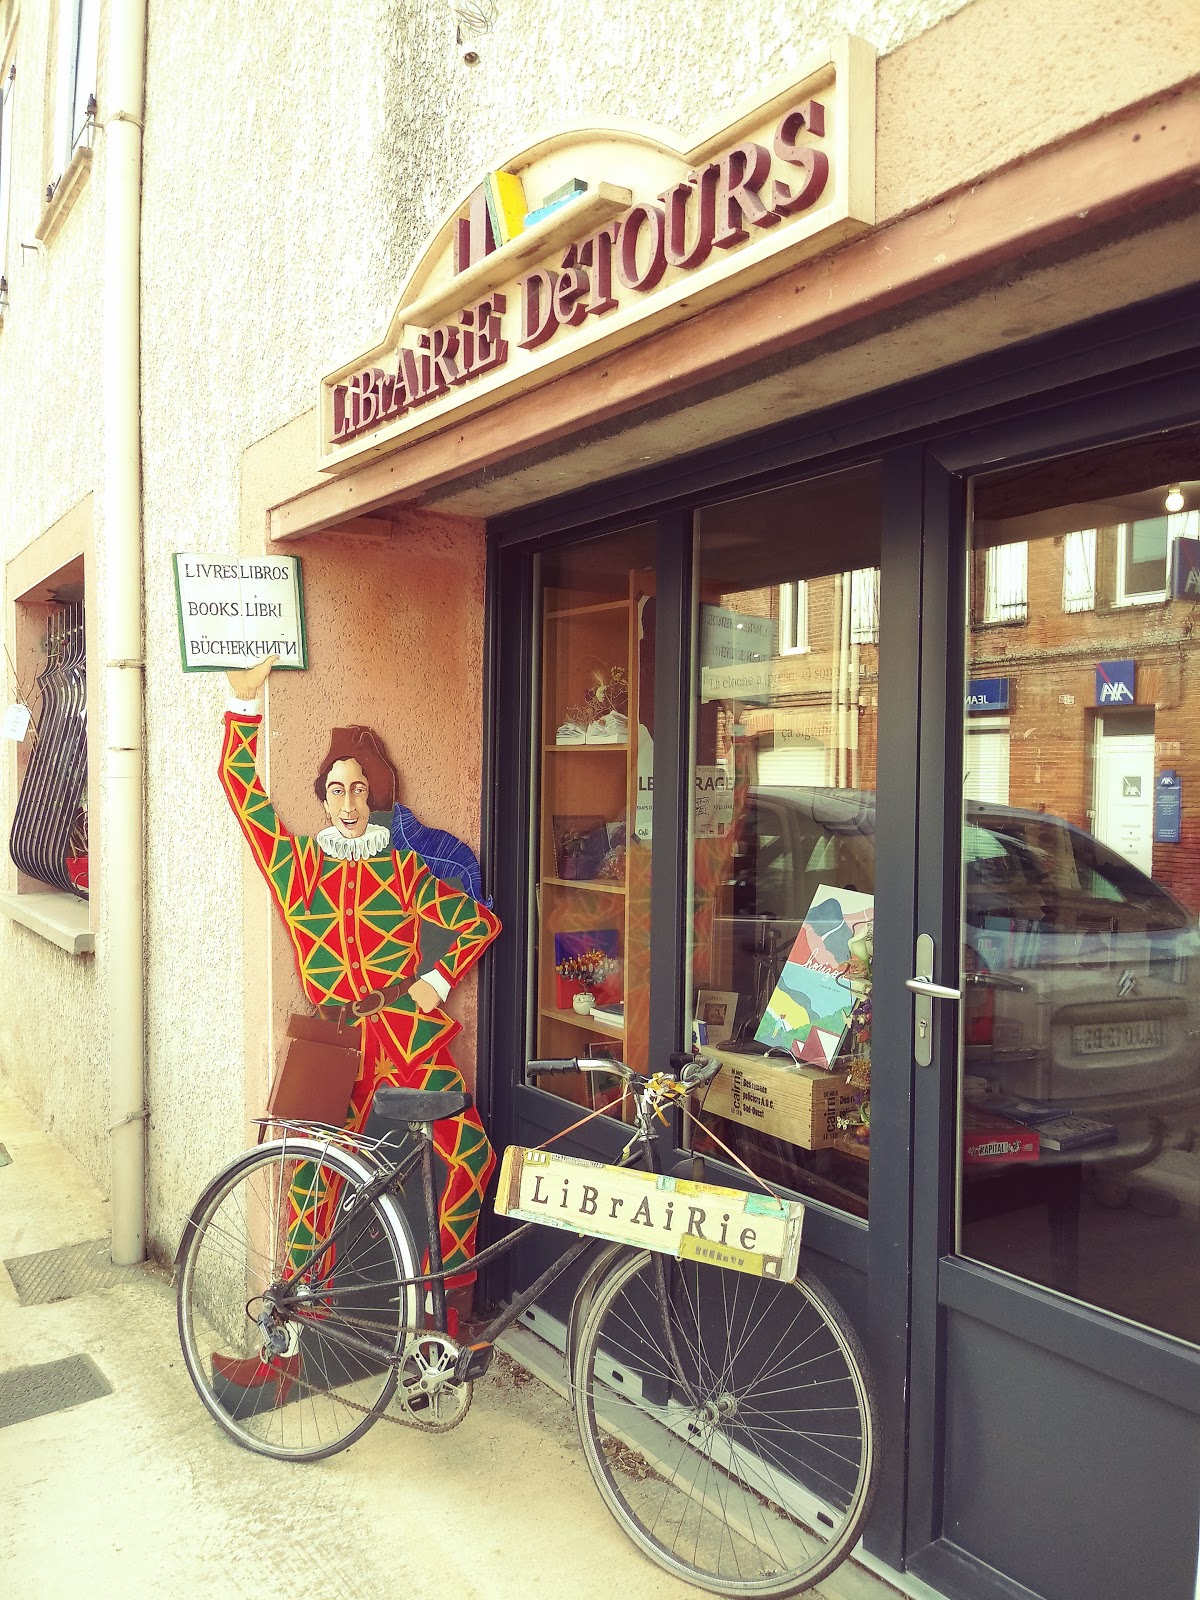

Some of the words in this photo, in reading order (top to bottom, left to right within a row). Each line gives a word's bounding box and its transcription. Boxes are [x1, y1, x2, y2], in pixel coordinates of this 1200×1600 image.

[246, 602, 282, 618] LIBRI
[731, 1075, 741, 1109] cairn
[824, 1096, 836, 1133] cairn
[530, 1175, 757, 1250] LiBrAiRie
